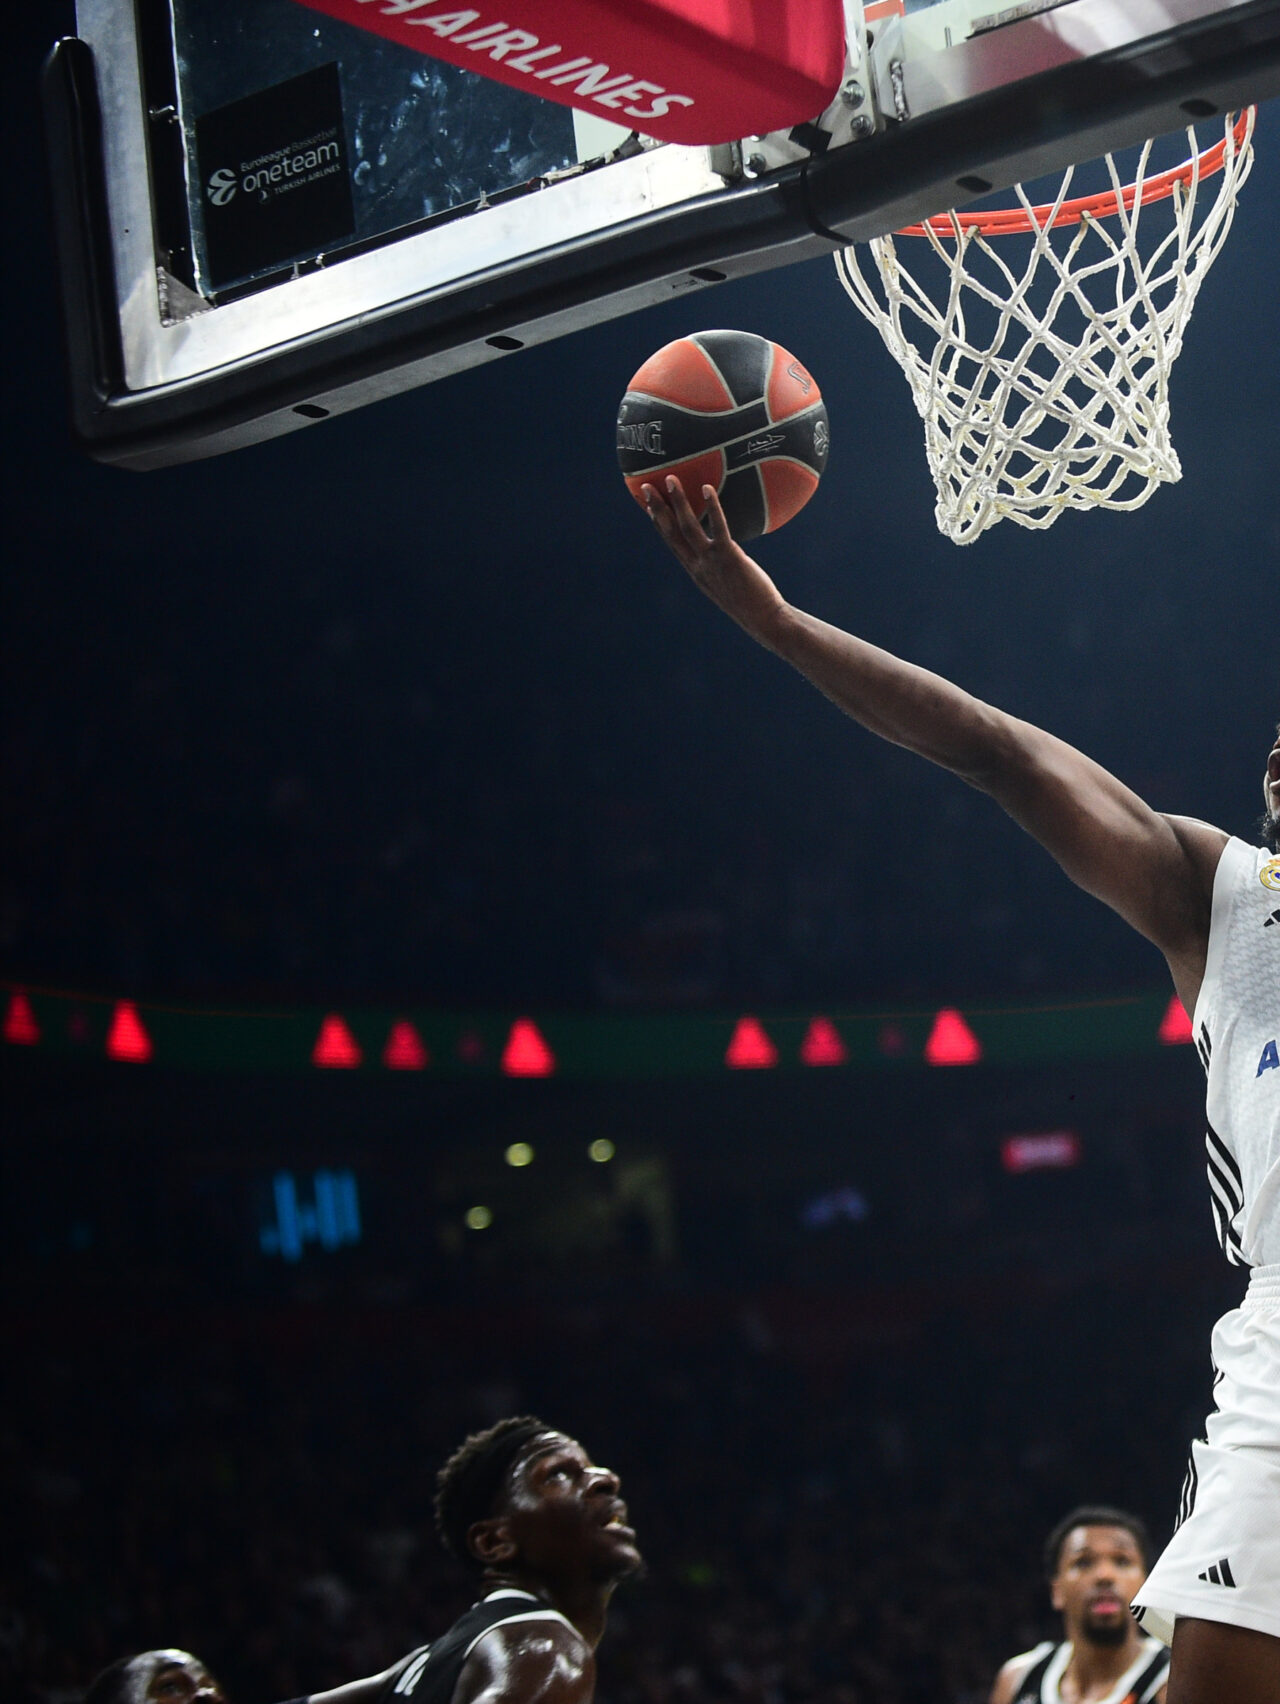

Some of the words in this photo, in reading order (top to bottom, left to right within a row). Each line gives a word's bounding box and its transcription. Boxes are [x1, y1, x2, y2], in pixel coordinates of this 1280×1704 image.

[404, 9, 694, 119] AIRLINES
[242, 141, 340, 192] oneteam
[274, 177, 306, 195] TURKISH
[308, 163, 341, 181] AIRLINES
